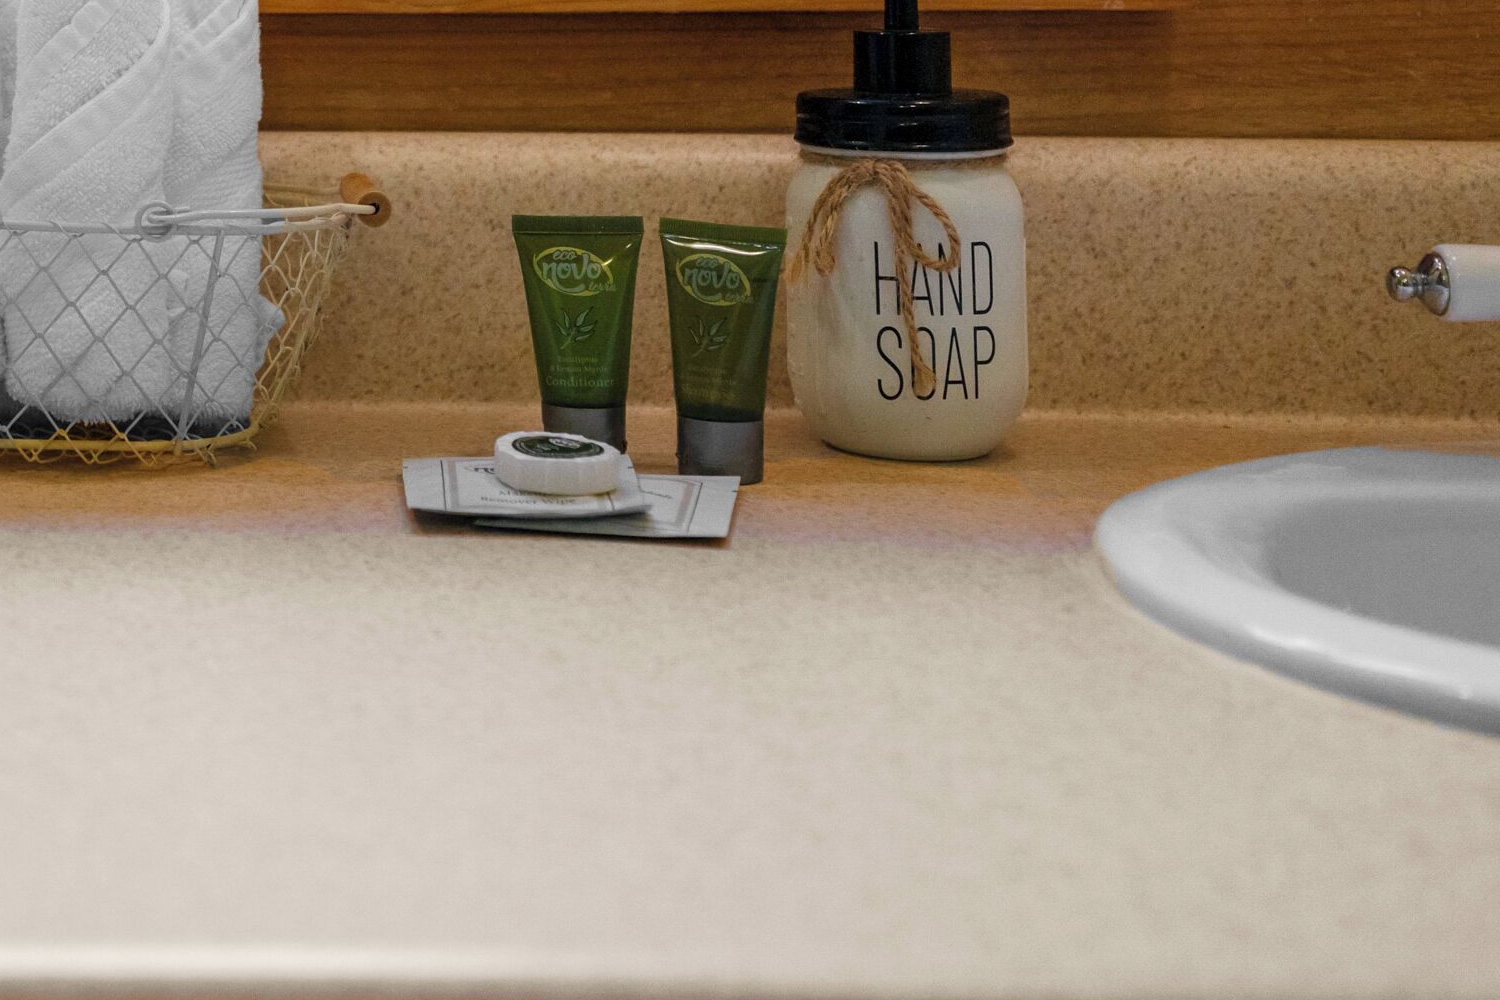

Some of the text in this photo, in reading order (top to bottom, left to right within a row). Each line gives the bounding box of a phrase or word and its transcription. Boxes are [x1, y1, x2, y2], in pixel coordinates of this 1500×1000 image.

[552, 251, 577, 261] eco
[874, 241, 994, 316] HAND
[545, 375, 615, 387] Conditioner
[876, 325, 996, 400] SOAP
